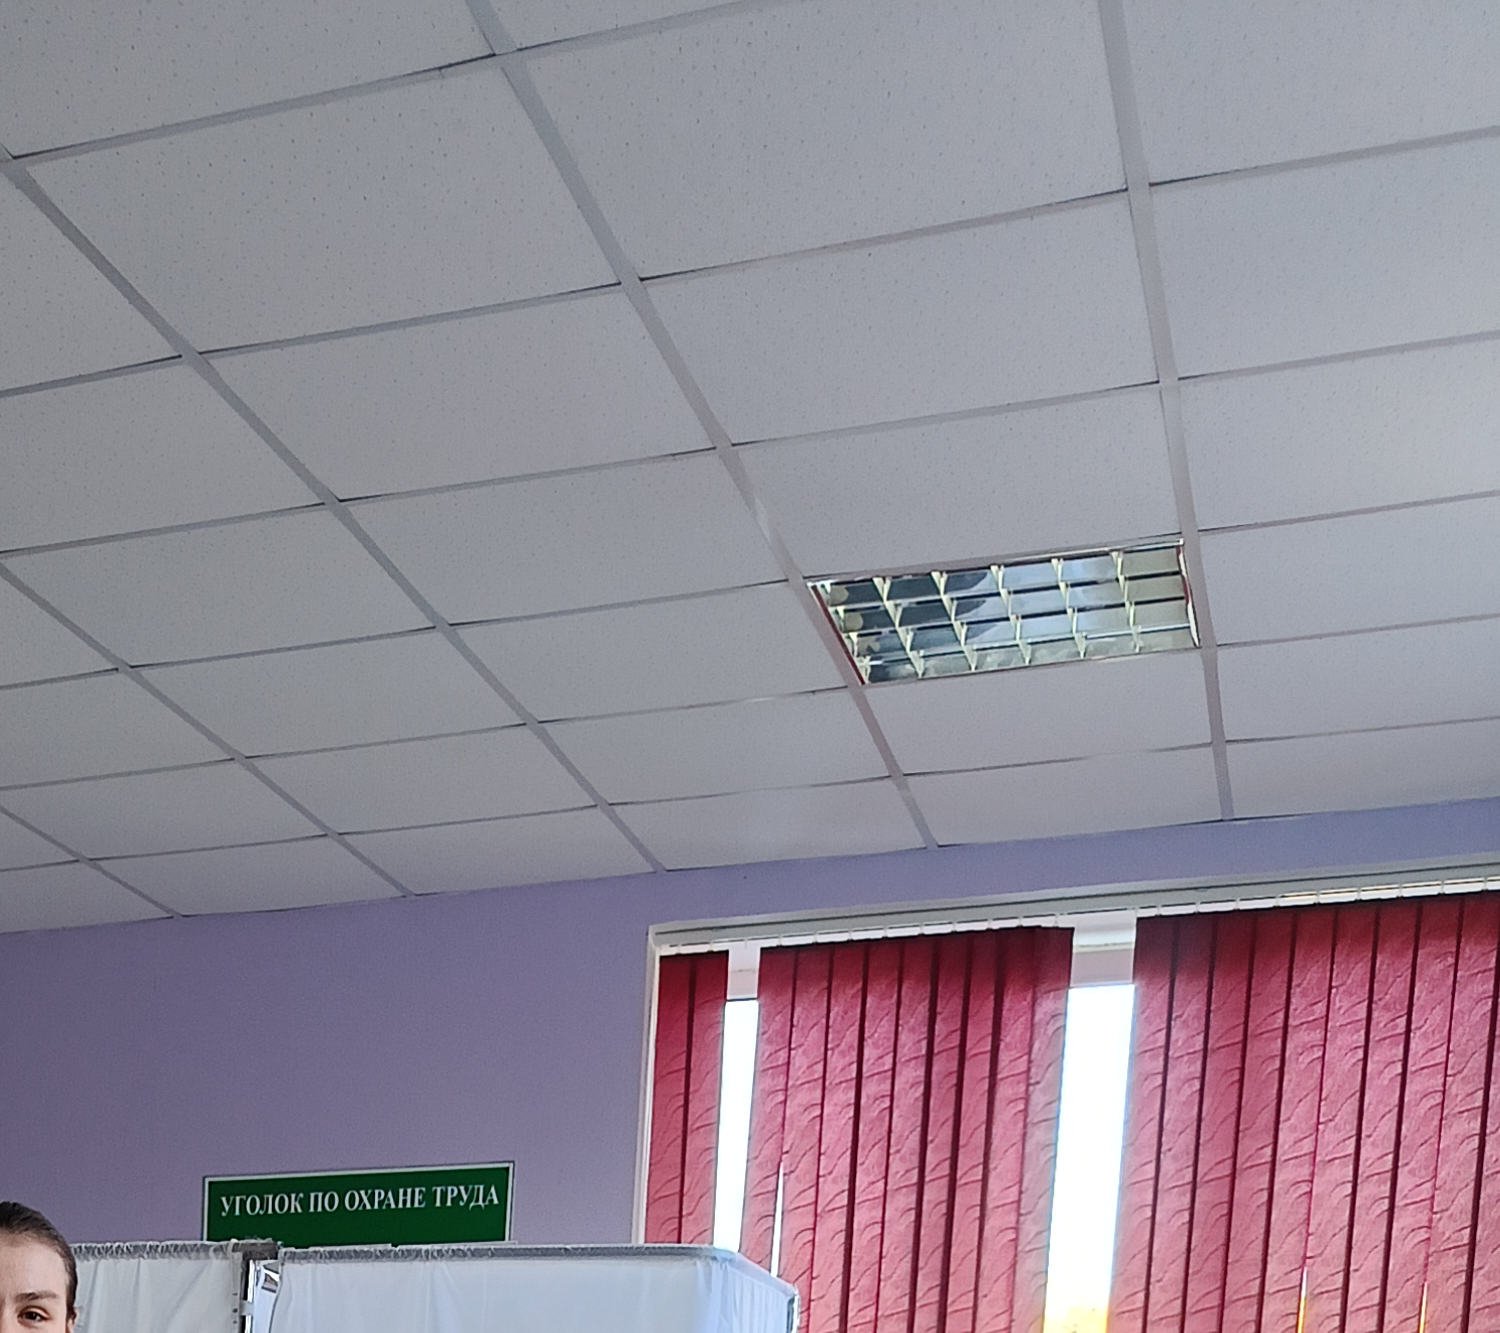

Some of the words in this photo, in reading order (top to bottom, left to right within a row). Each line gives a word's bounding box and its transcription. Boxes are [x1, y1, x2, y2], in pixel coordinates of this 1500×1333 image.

[220, 1192, 304, 1217] УГОЛОК
[308, 1191, 339, 1213] ПО
[344, 1186, 426, 1212] ОХРАНЕ
[432, 1184, 500, 1210] ТРУДА
